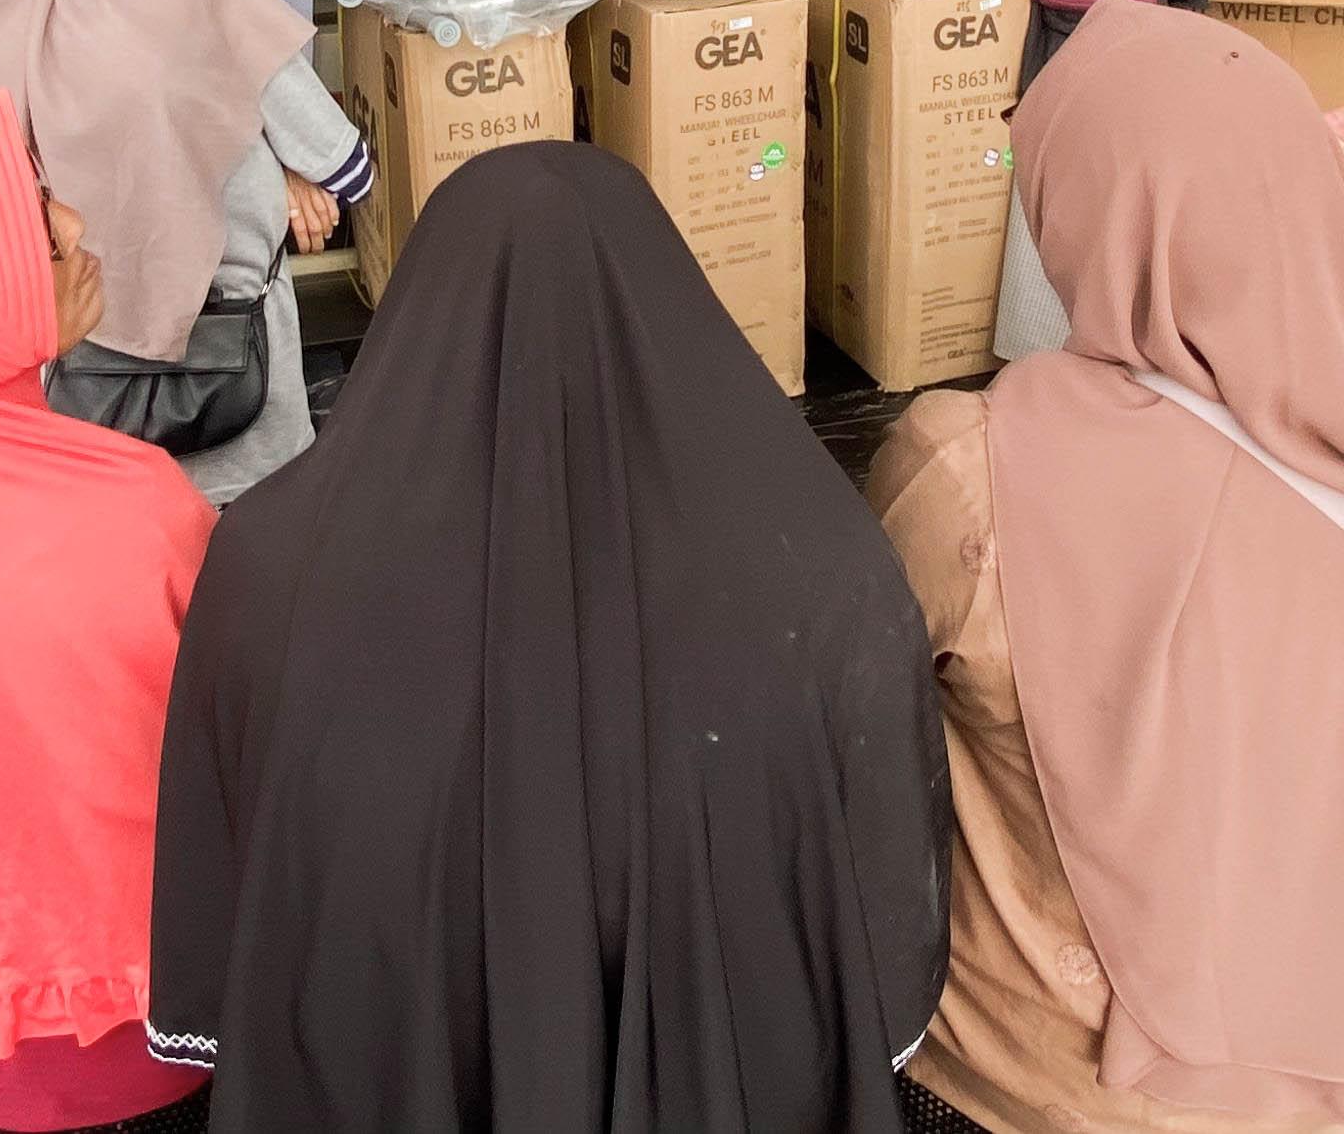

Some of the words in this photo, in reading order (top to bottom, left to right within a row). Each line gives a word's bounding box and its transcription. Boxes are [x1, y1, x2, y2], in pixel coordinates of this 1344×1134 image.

[1220, 2, 1306, 23] WHEEL
[848, 22, 867, 53] SL
[934, 13, 999, 50] GEA
[613, 42, 629, 73] SL
[695, 31, 763, 70] GEA
[445, 55, 525, 97] GEA
[932, 75, 953, 92] FS
[958, 71, 988, 89] 863
[994, 67, 1008, 84] M
[694, 95, 716, 114] FS
[722, 89, 752, 109] 863
[759, 85, 774, 104] M
[920, 100, 957, 113] MANUAL
[449, 121, 474, 142] FS
[481, 118, 517, 139] 863
[524, 112, 540, 130] M
[944, 107, 995, 125] STEEL
